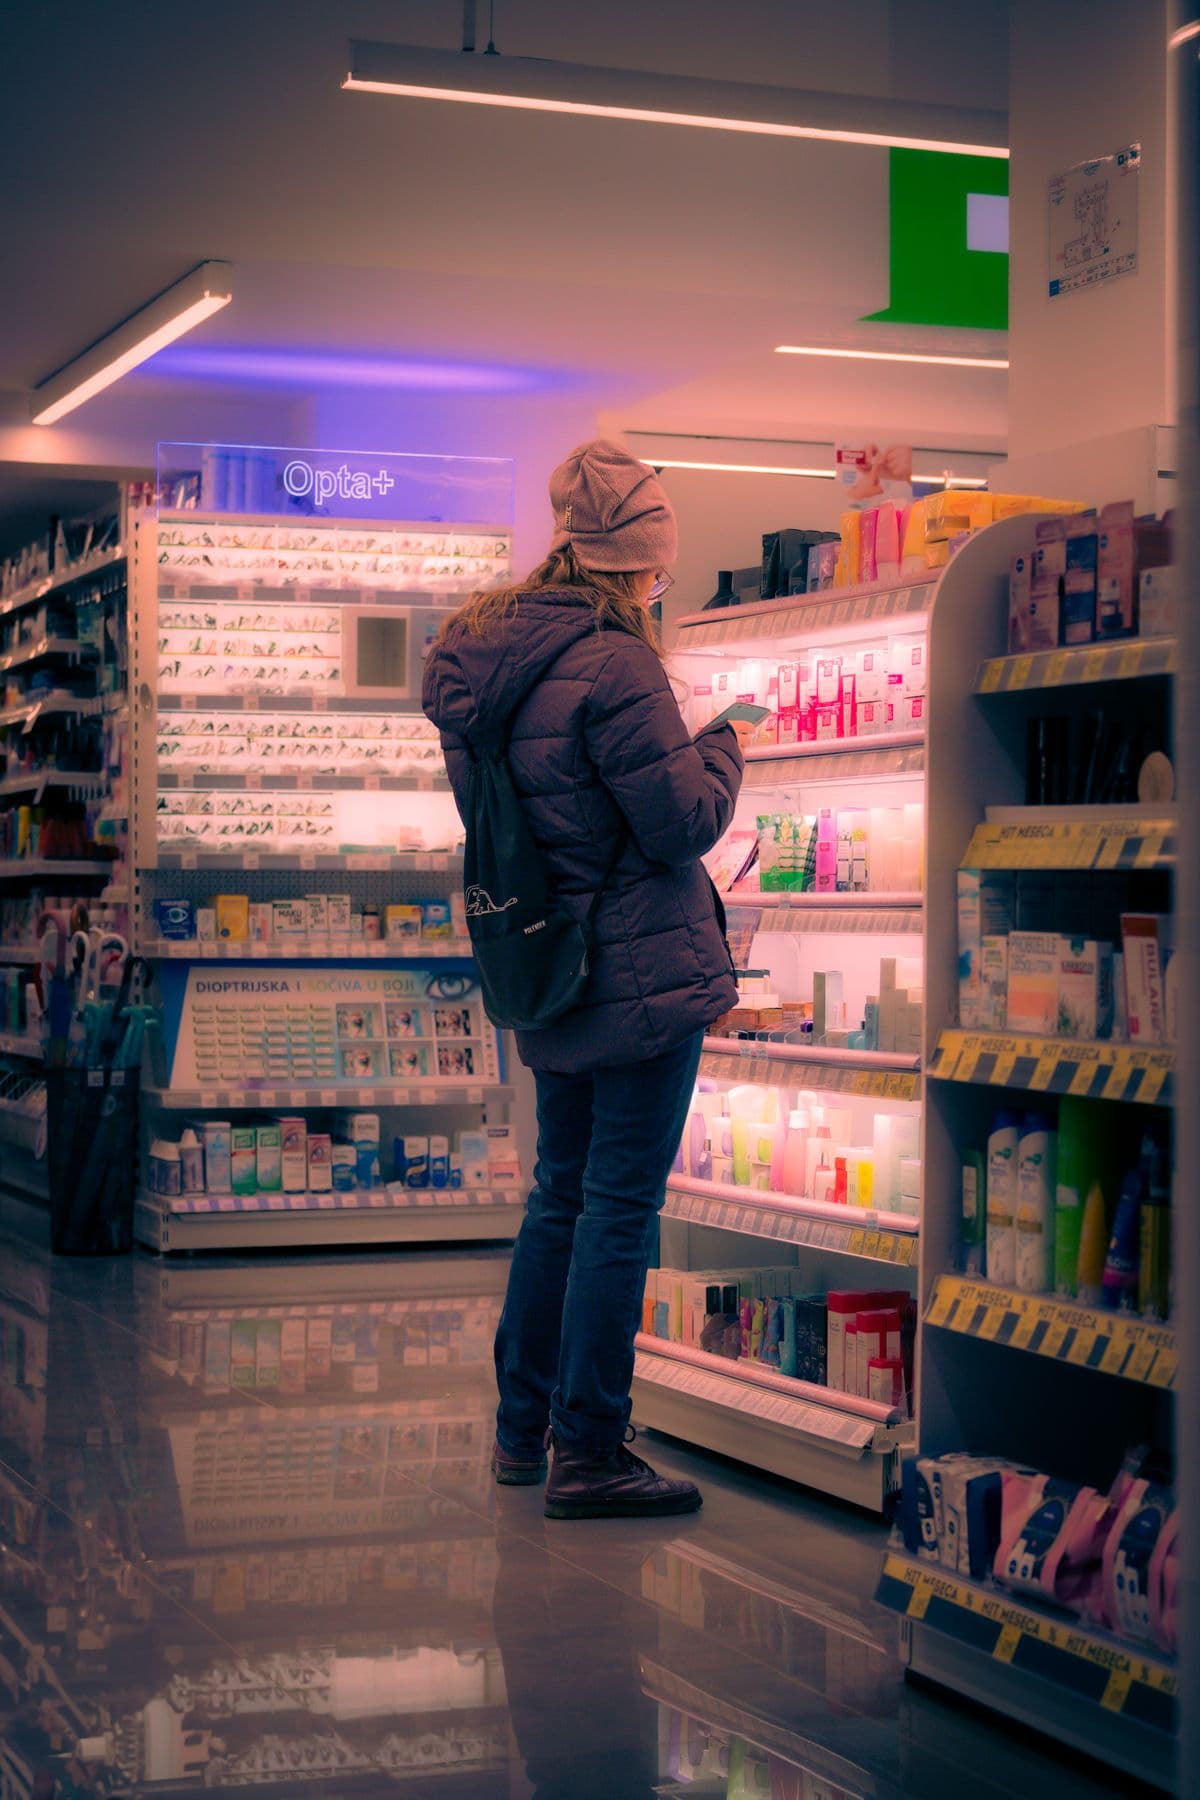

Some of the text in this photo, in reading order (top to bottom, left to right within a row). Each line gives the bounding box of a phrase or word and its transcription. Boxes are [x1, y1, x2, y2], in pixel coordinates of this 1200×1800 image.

[283, 460, 394, 505] Opta+
[195, 979, 290, 994] DIOPTRIJSKA
[367, 980, 378, 993] U
[383, 979, 415, 993] BOJI
[963, 1036, 979, 1050] HIT
[980, 1038, 1016, 1052] MESECA
[1042, 1043, 1059, 1057] HIT
[1060, 1045, 1100, 1060] MESECA
[960, 1285, 976, 1299] HIT
[977, 1289, 1012, 1309] MESECA
[1038, 1303, 1056, 1318] HIT
[1057, 1308, 1097, 1330] MESECA
[904, 1567, 921, 1583] HIT
[981, 1600, 1001, 1617] HIT
[1002, 1607, 1040, 1635] MESECA
[1067, 1631, 1087, 1649] HIT
[1088, 1641, 1131, 1672] MESECA
